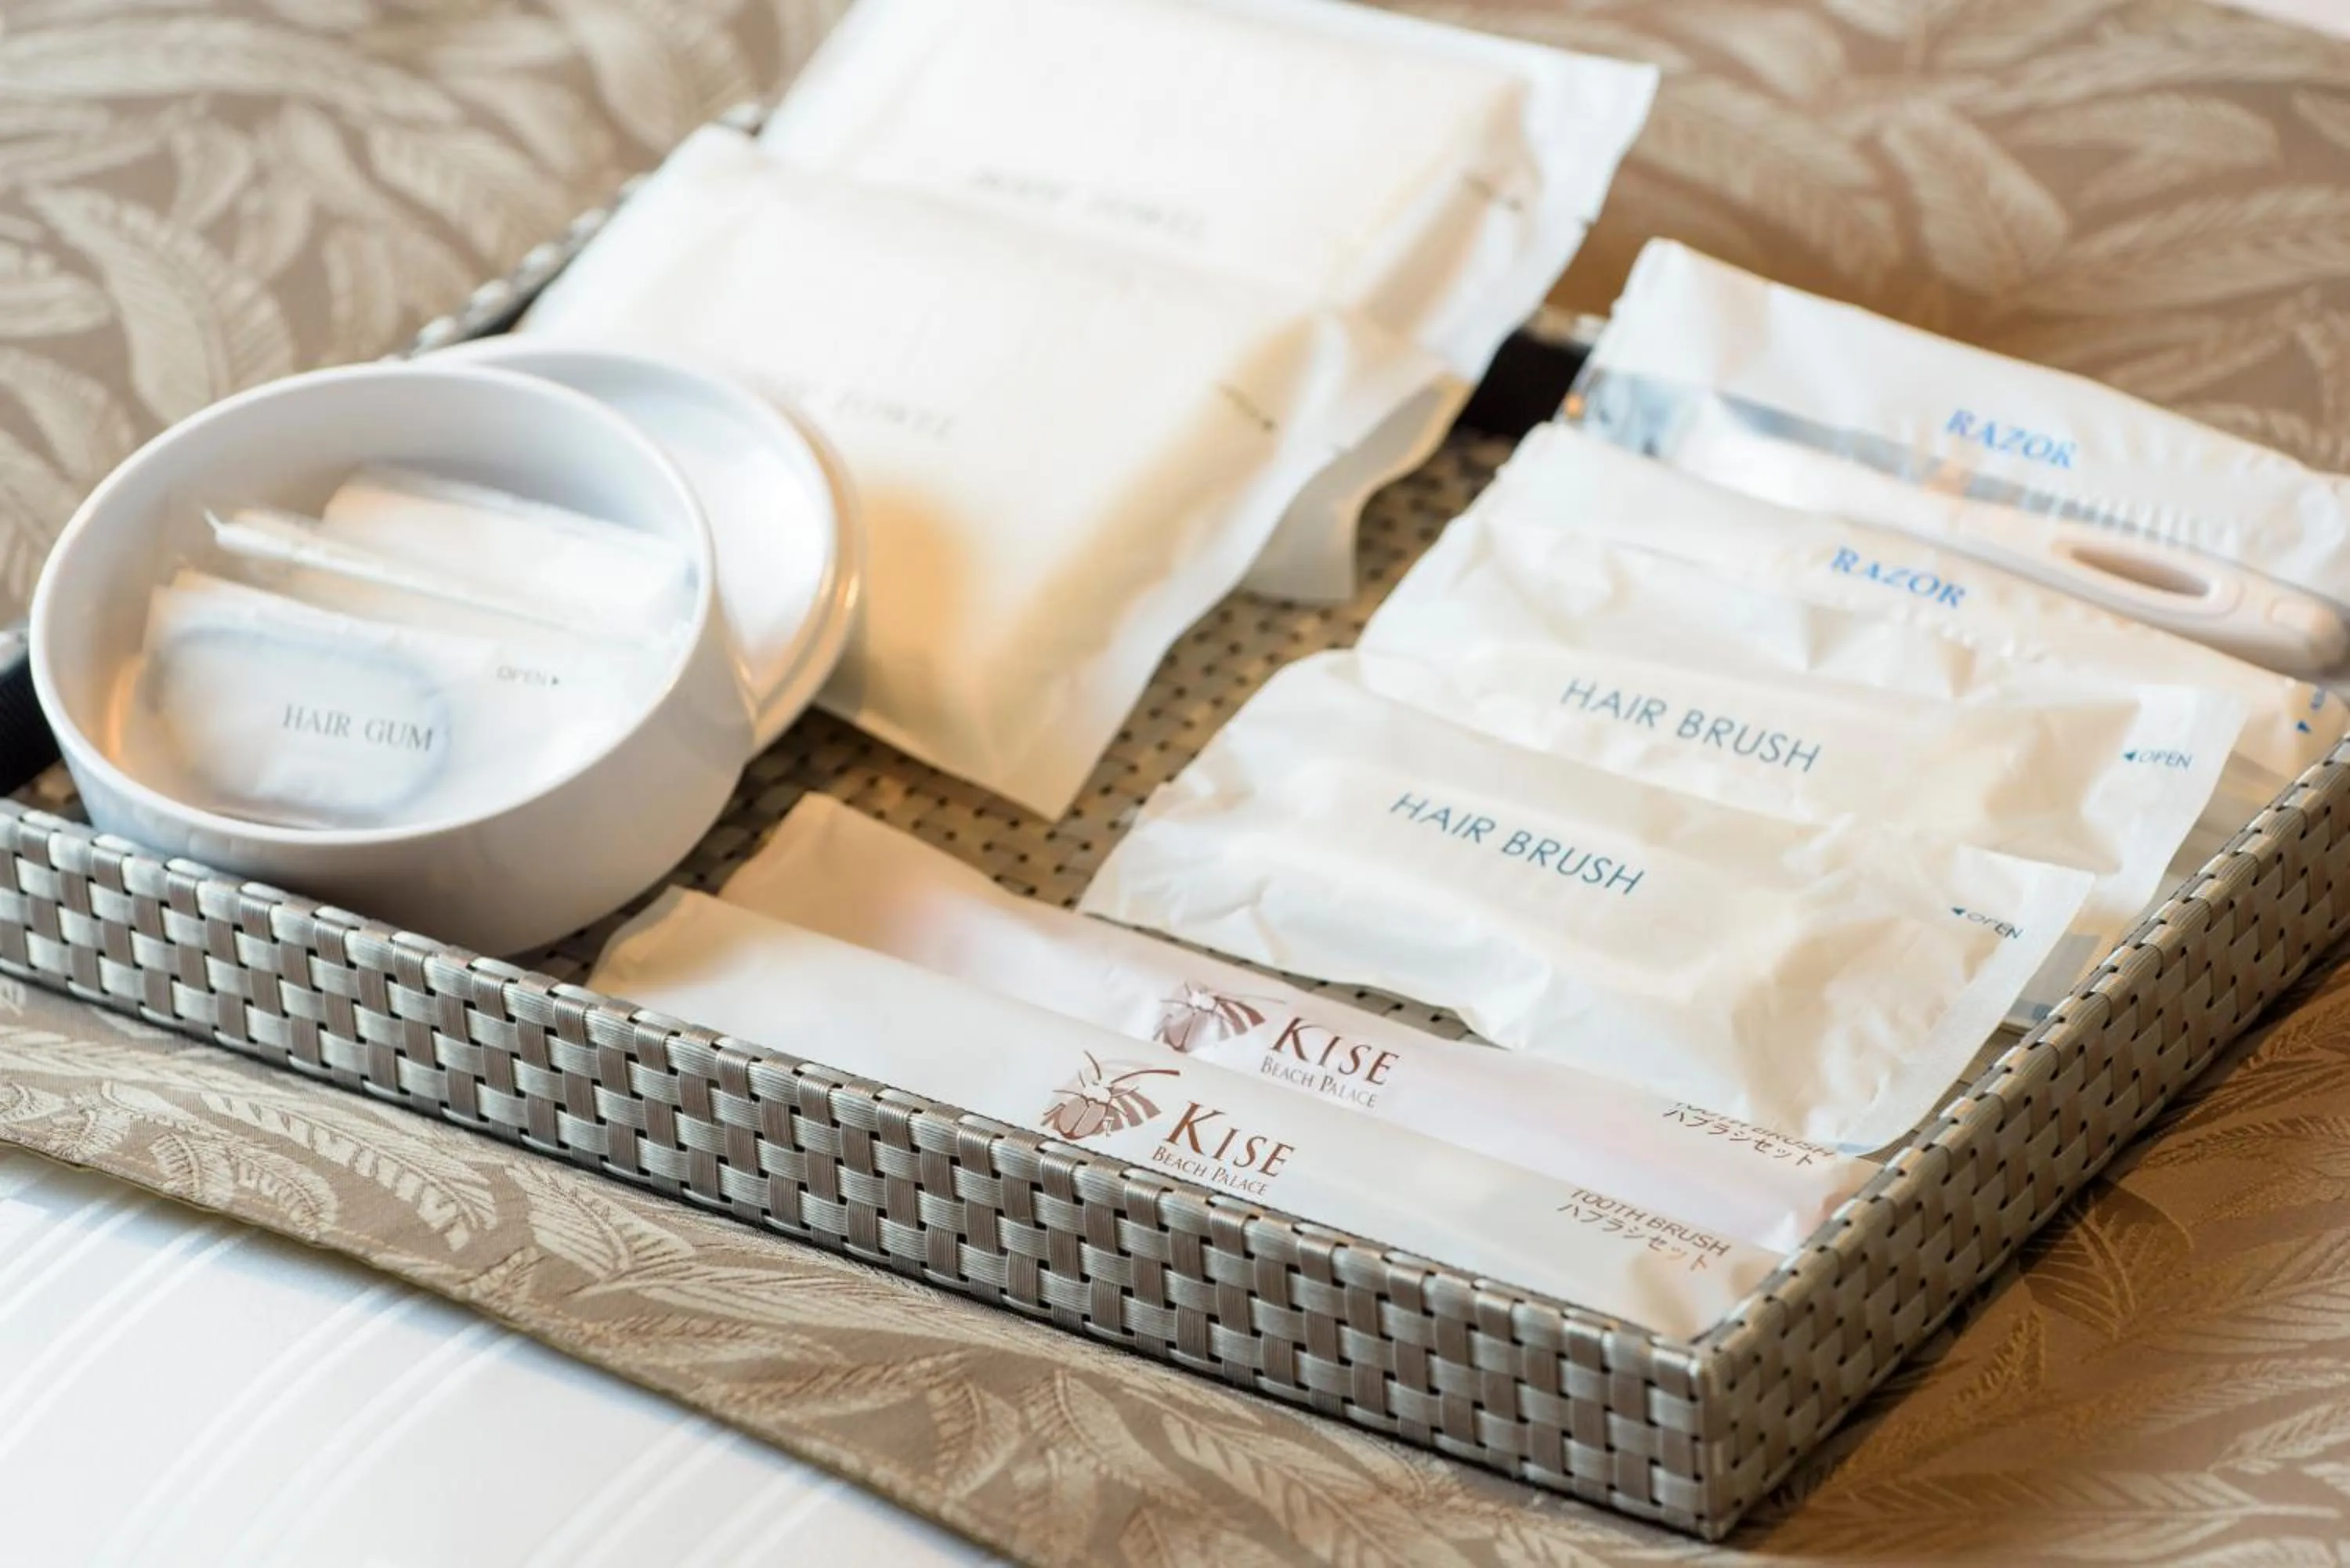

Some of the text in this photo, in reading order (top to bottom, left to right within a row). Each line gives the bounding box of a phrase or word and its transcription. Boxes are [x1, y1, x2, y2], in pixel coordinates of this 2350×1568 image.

[1944, 408, 2077, 470] RAZOR
[1830, 545, 1967, 609] RAZOR
[495, 664, 548, 686] OPEN
[282, 703, 434, 753] HAIR GUM
[1560, 677, 1822, 773] HAIR BRUSH
[2138, 748, 2194, 770] OPEN
[1389, 790, 1646, 896] HAIR BRUSH
[1966, 912, 2026, 939] OPEN
[1260, 1053, 1379, 1110] BEACH PALACE
[1270, 1015, 1401, 1087] KISE
[1162, 1100, 1296, 1178] KISE
[1151, 1144, 1268, 1198] BEACH PALACE
[1570, 1187, 1732, 1257] TOOTH BRUSH
